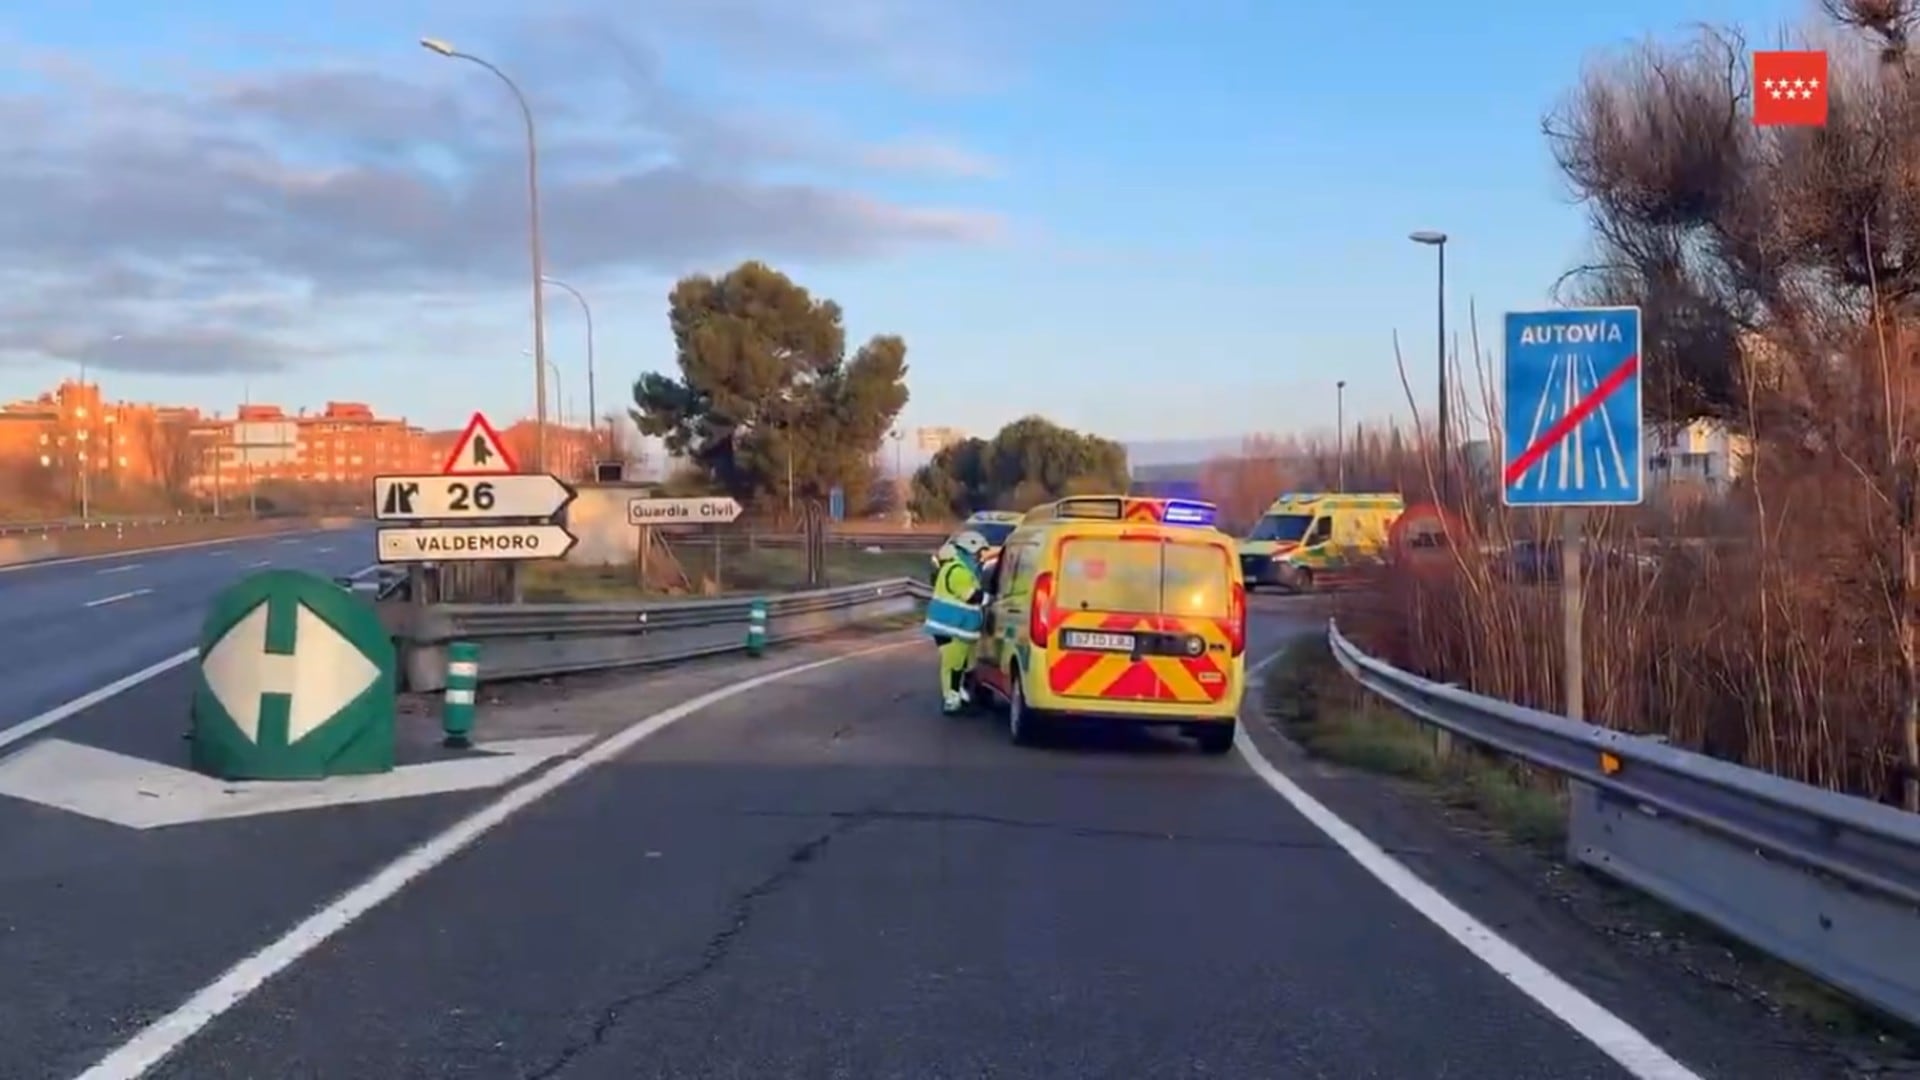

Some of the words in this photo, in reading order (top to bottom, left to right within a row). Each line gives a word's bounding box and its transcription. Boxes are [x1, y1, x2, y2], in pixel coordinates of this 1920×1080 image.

[1520, 319, 1622, 344] AUTOVÍA
[447, 482, 495, 511] 26
[633, 505, 689, 518] Guardia
[700, 503, 733, 516] Civil
[416, 535, 540, 552] VALDEMORO
